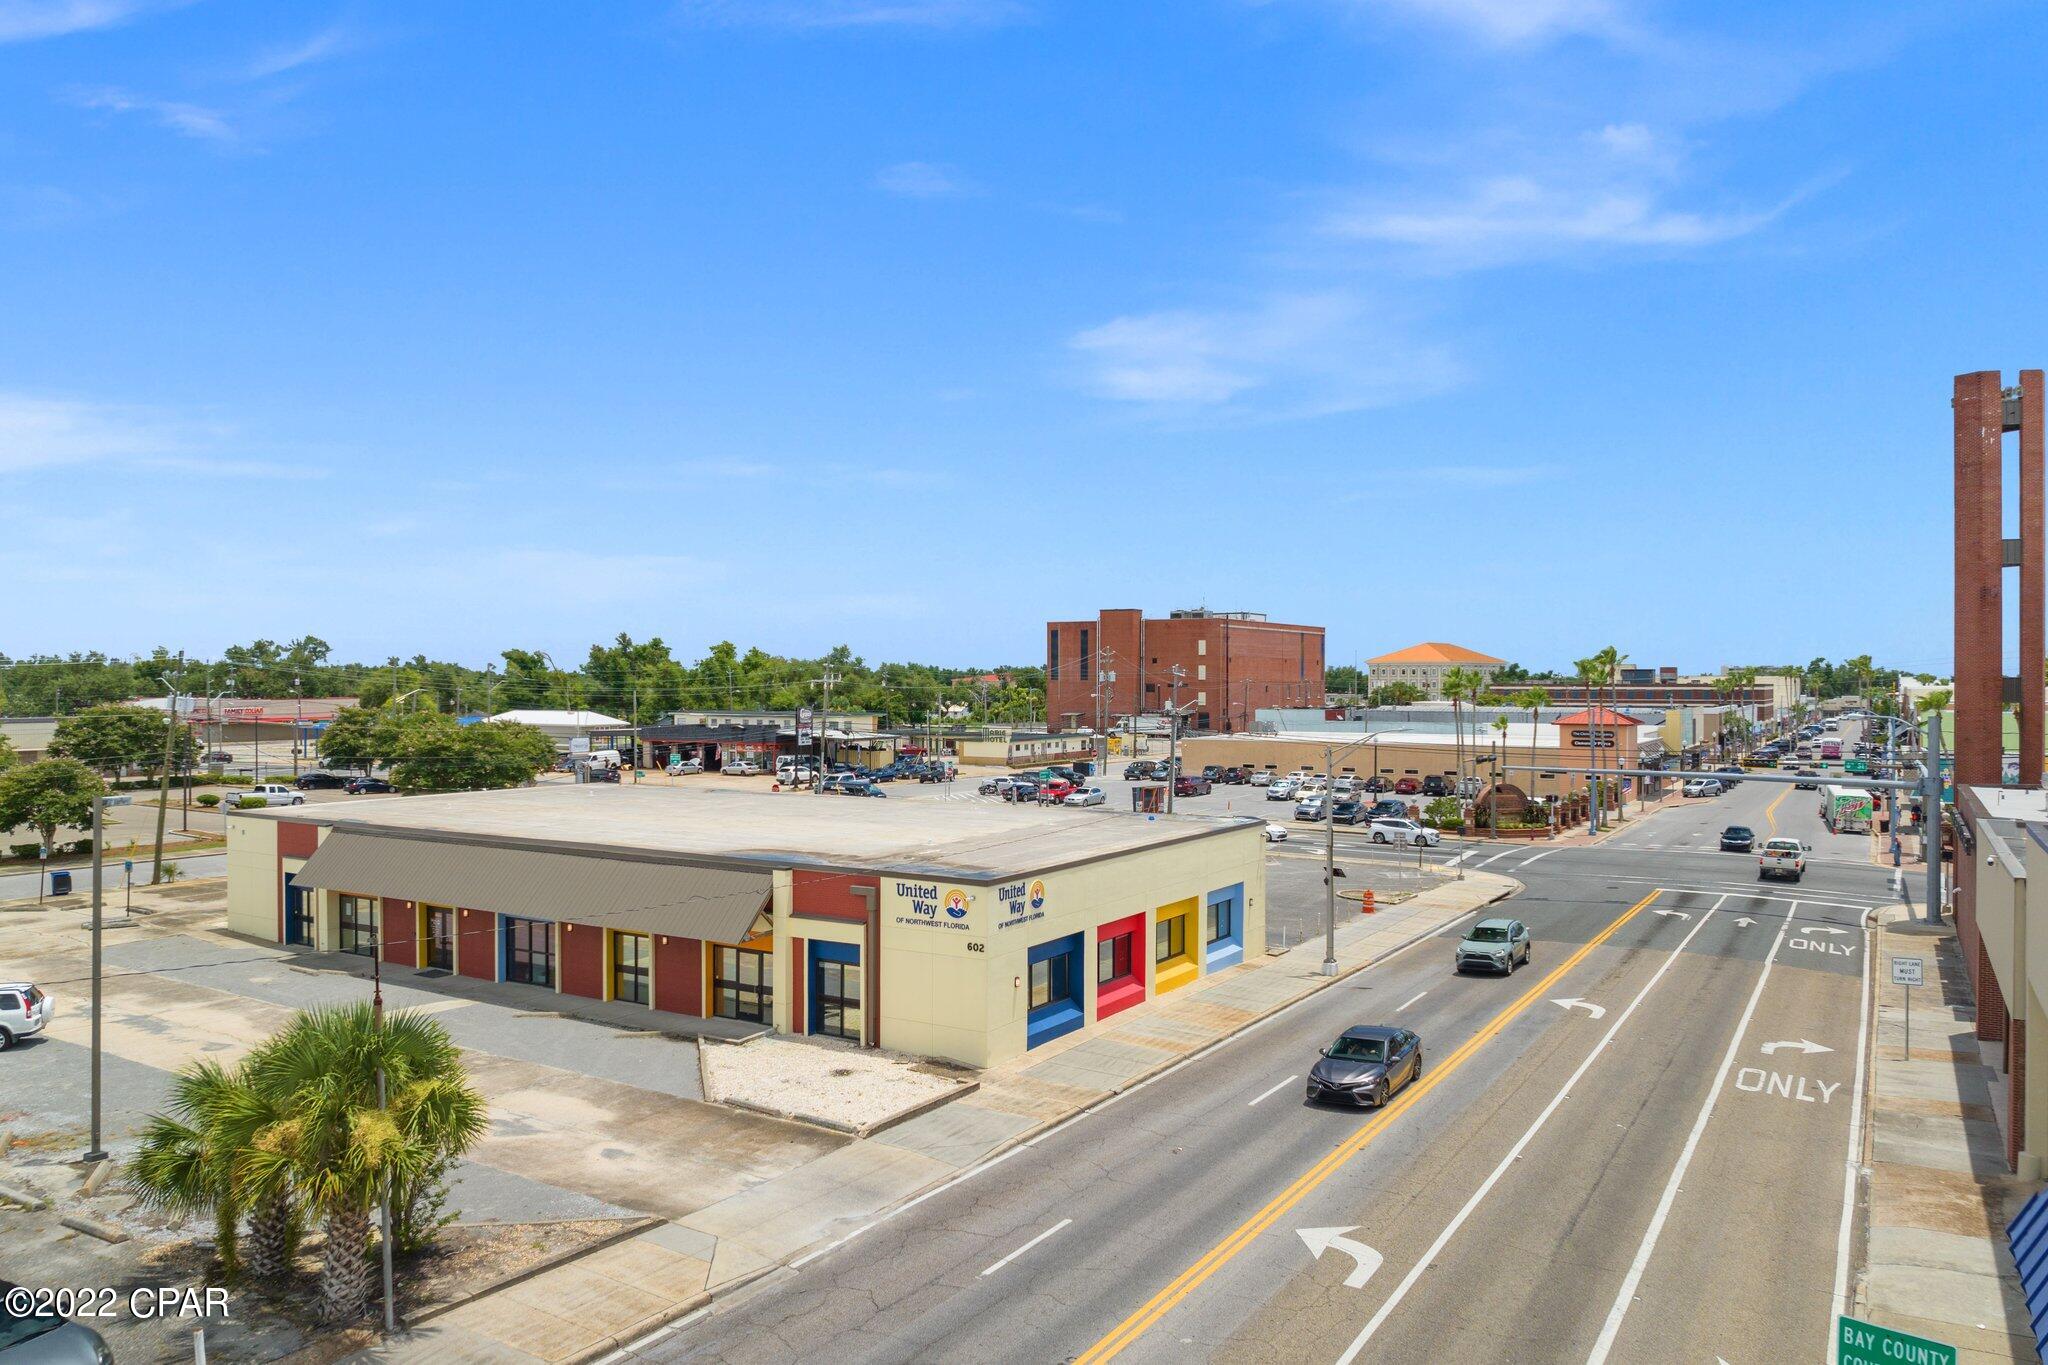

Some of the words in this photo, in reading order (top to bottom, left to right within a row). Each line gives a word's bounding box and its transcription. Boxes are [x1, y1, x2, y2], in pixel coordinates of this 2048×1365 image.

[896, 883, 938, 900] United
[998, 882, 1026, 902] United
[912, 900, 938, 919] Way
[1009, 900, 1026, 916] Way
[905, 918, 942, 928] NORTHWEST
[943, 921, 970, 930] FLORIDA
[967, 942, 985, 953] 602
[1789, 938, 1856, 956] ONLY
[1736, 1067, 1841, 1104] ONLY
[1843, 1326, 1876, 1351] BAY
[1882, 1338, 1950, 1365] COUNTY
